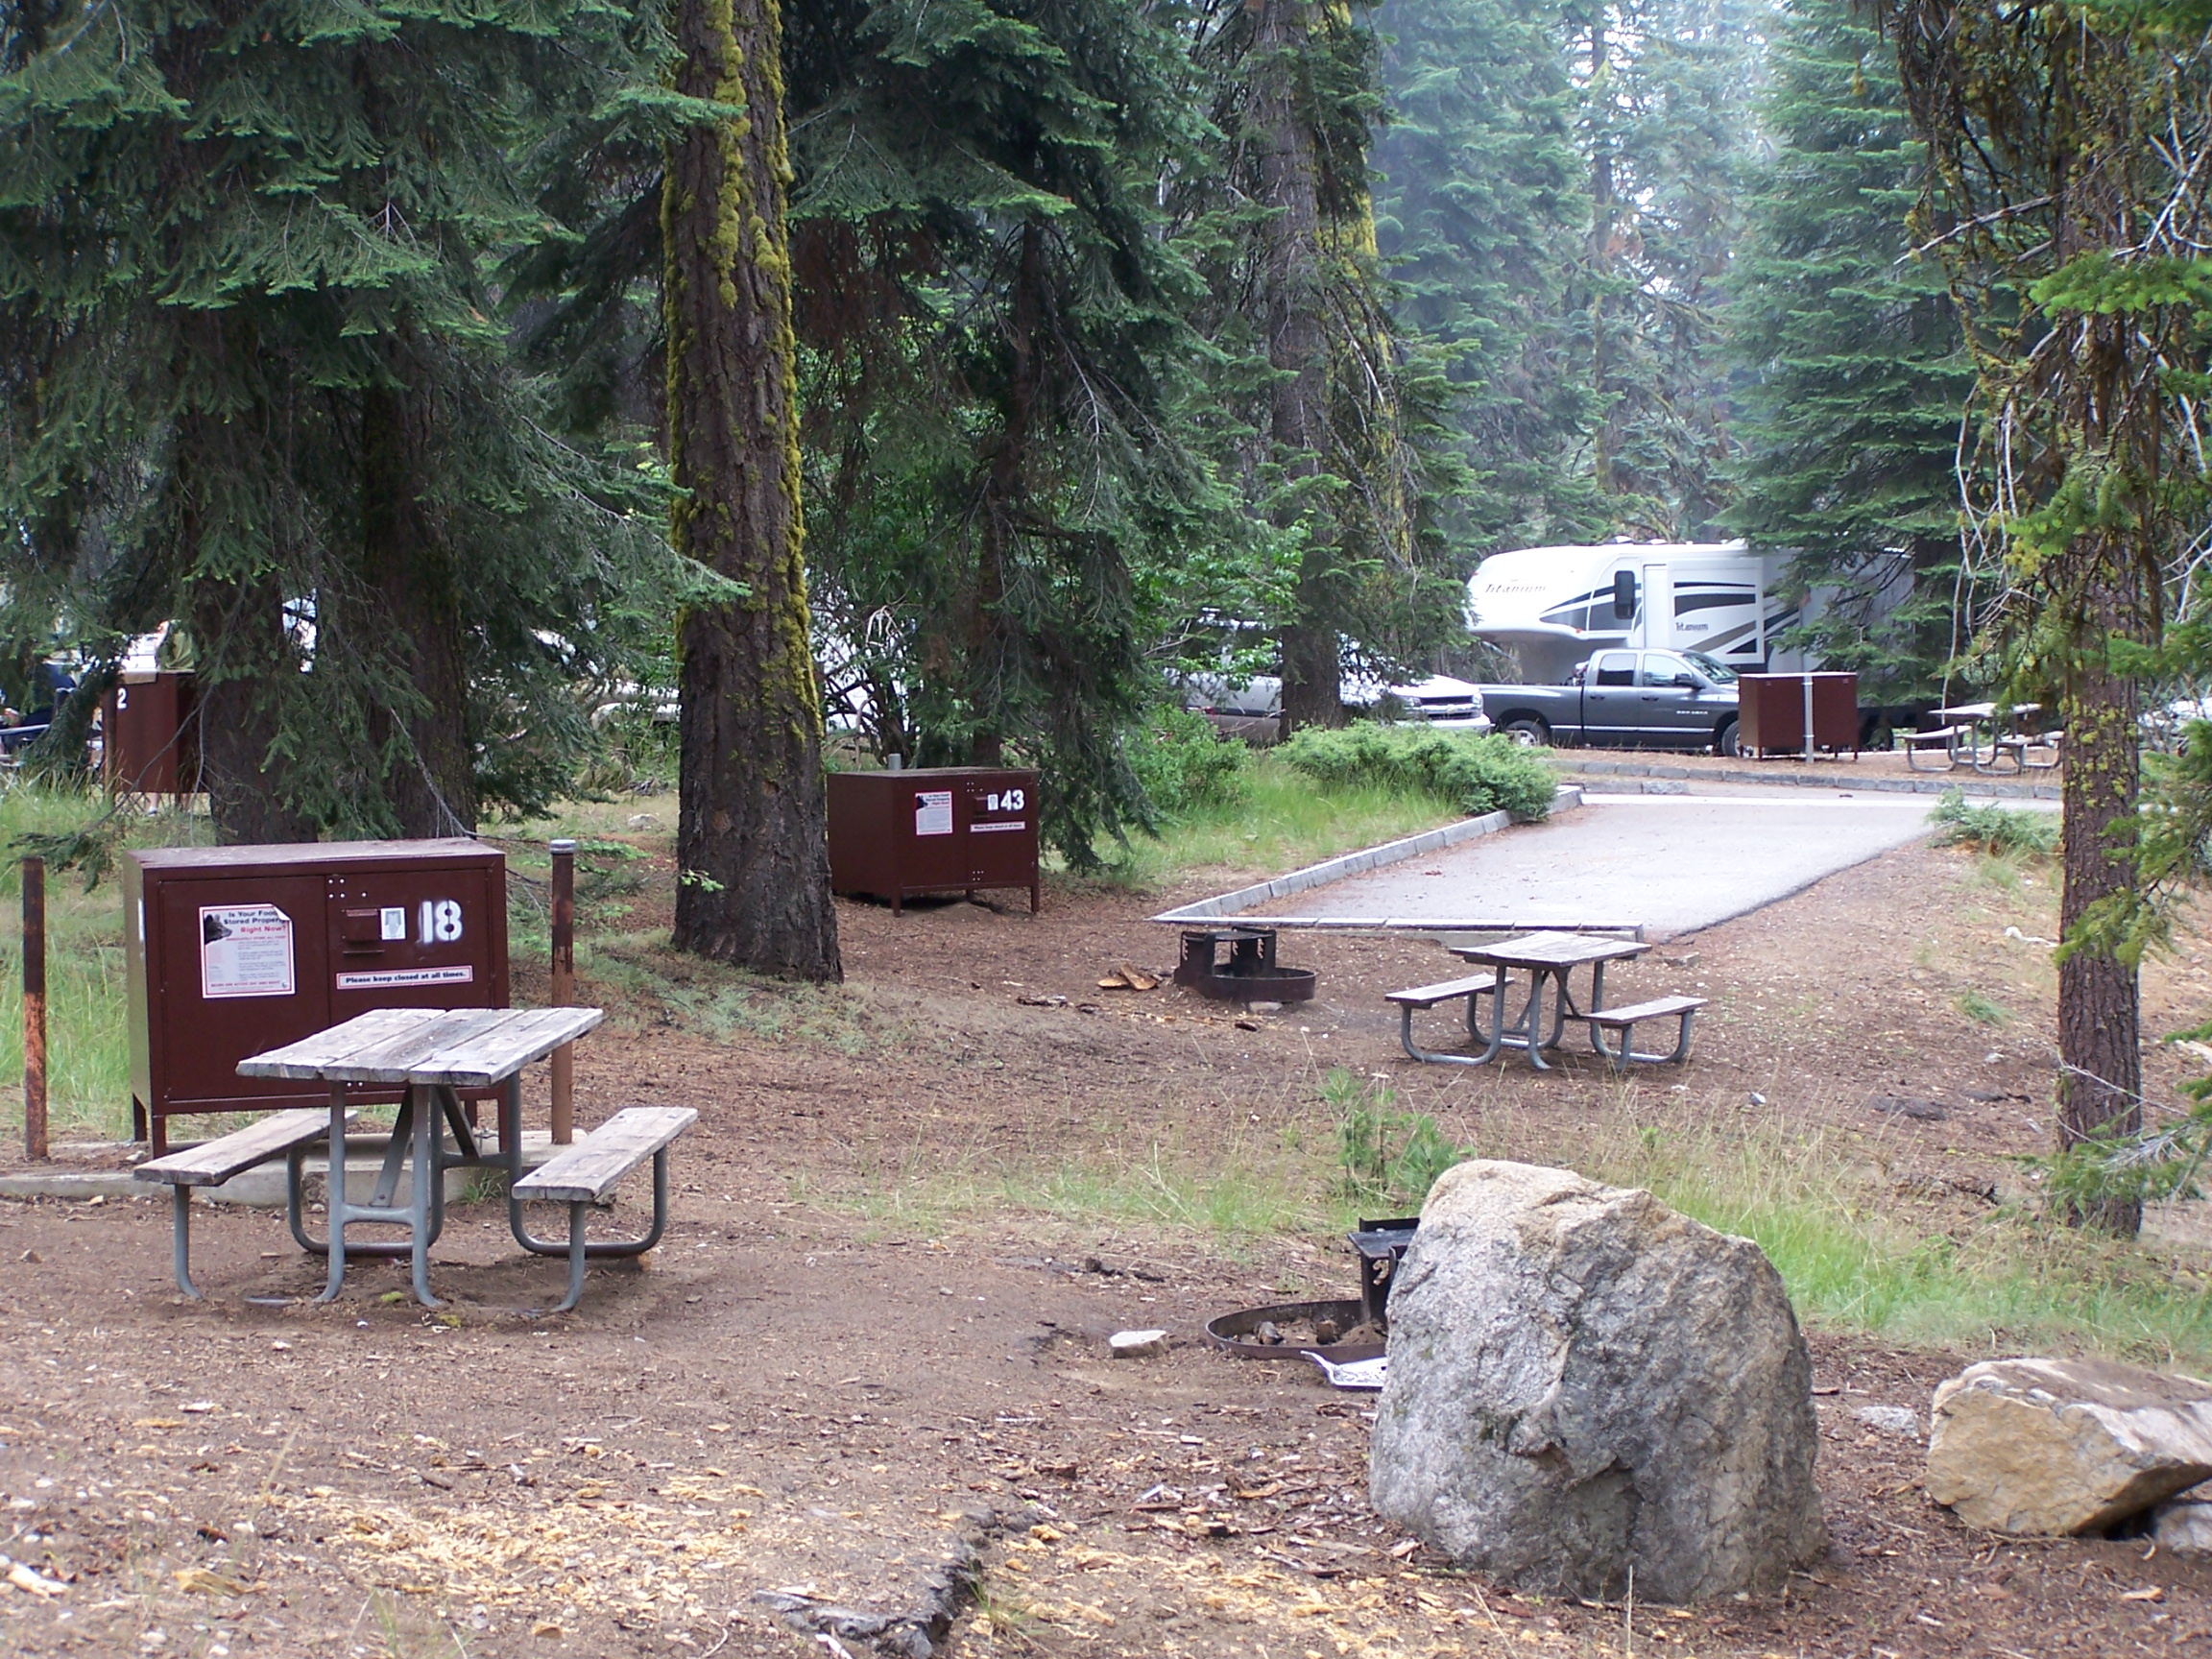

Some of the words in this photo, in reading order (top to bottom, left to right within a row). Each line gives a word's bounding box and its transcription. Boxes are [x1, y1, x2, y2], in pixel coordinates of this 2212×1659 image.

[117, 687, 127, 709] 2
[1000, 789, 1024, 811] 43
[240, 926, 261, 934] Right
[421, 900, 463, 944] 18
